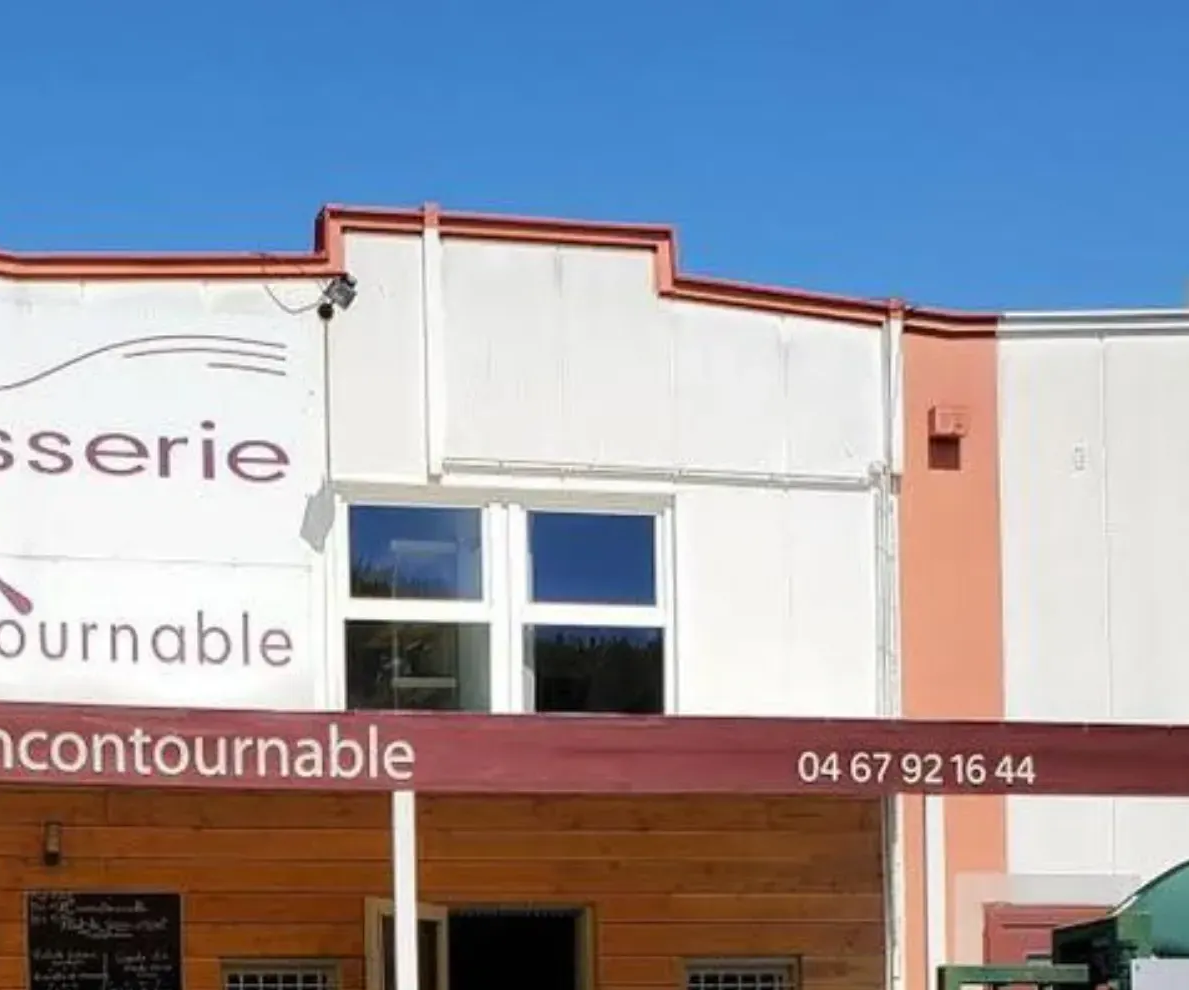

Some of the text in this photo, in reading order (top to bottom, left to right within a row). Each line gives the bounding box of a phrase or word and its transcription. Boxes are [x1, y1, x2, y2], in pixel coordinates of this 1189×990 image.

[797, 751, 1037, 785] 04 67 92 16 44
